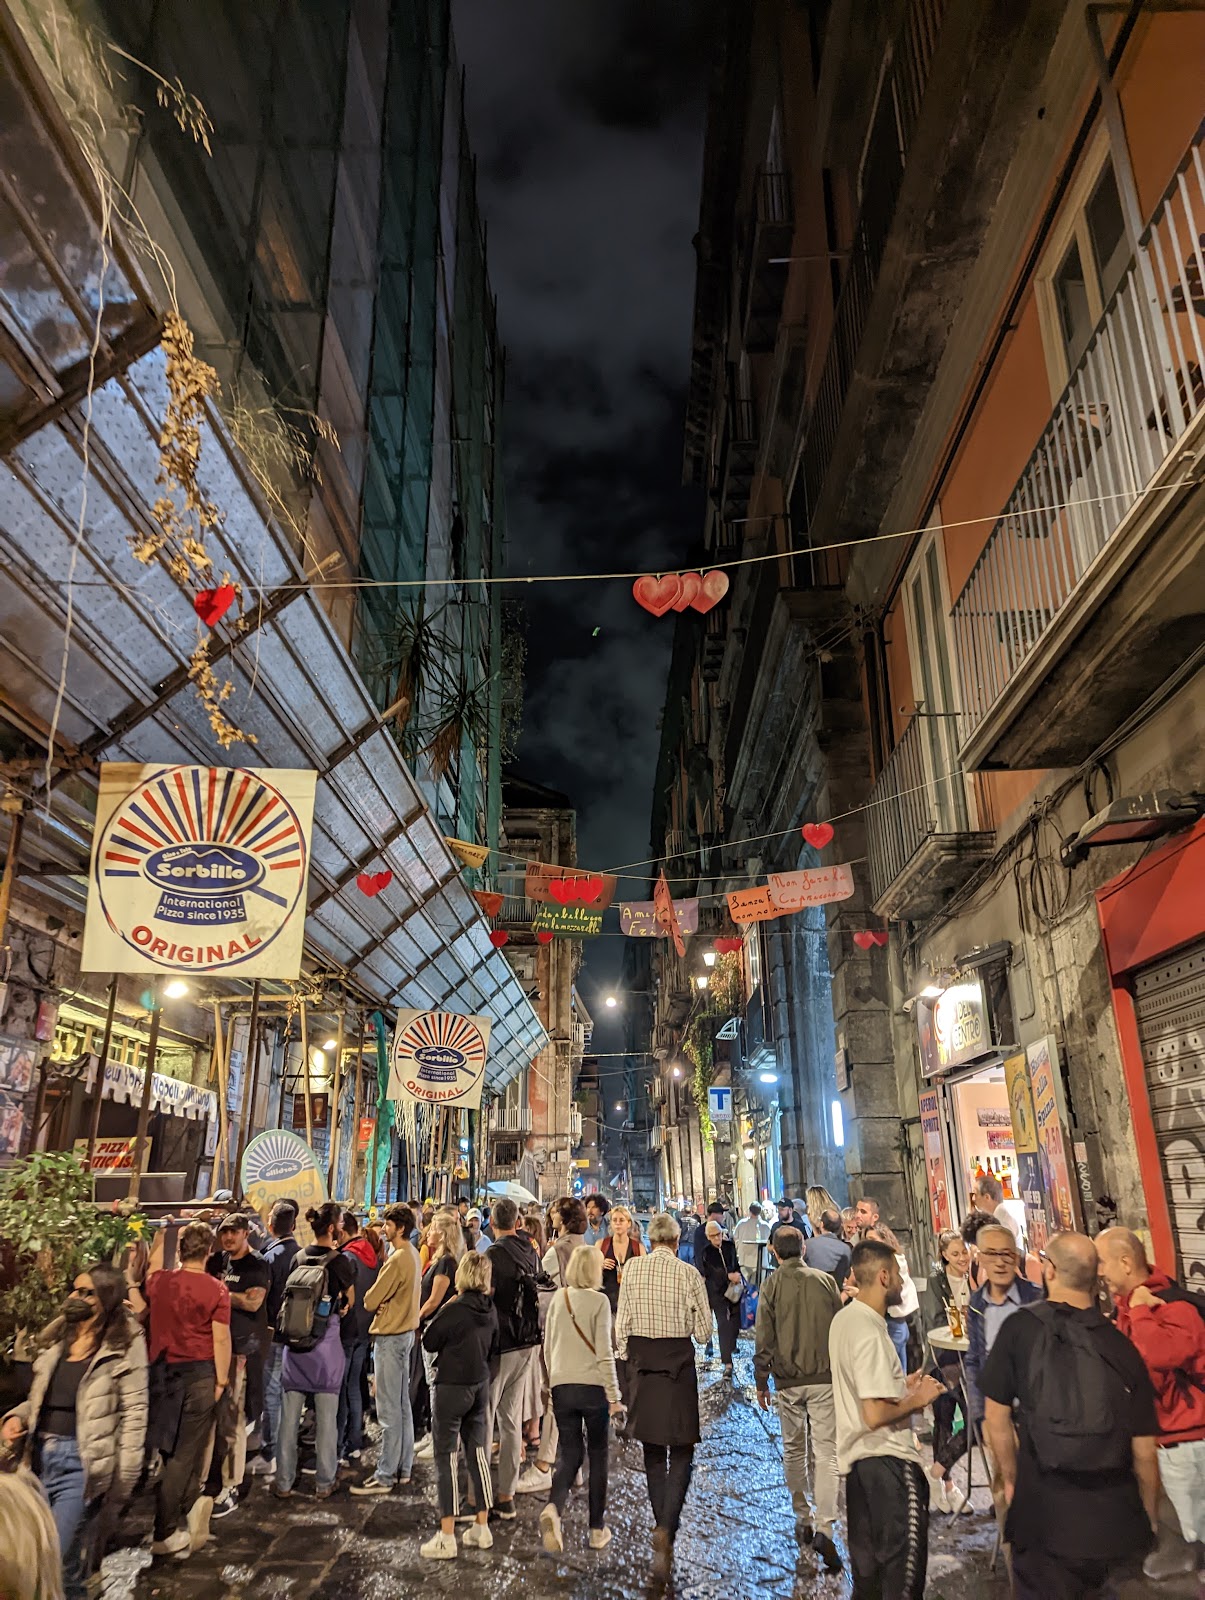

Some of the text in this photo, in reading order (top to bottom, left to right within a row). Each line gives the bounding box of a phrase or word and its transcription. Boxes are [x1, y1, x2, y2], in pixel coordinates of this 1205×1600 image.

[156, 863, 246, 879] Sorbillo
[163, 895, 240, 908] International
[157, 906, 245, 920] Pizza since 1935
[131, 926, 262, 963] ORIGINAL
[419, 1054, 458, 1064] Sorbillo
[104, 1064, 121, 1084] ew
[420, 1068, 455, 1076] International
[406, 1081, 463, 1099] ORIGINAL
[710, 1089, 730, 1110] T
[97, 1142, 130, 1153] PIZZA
